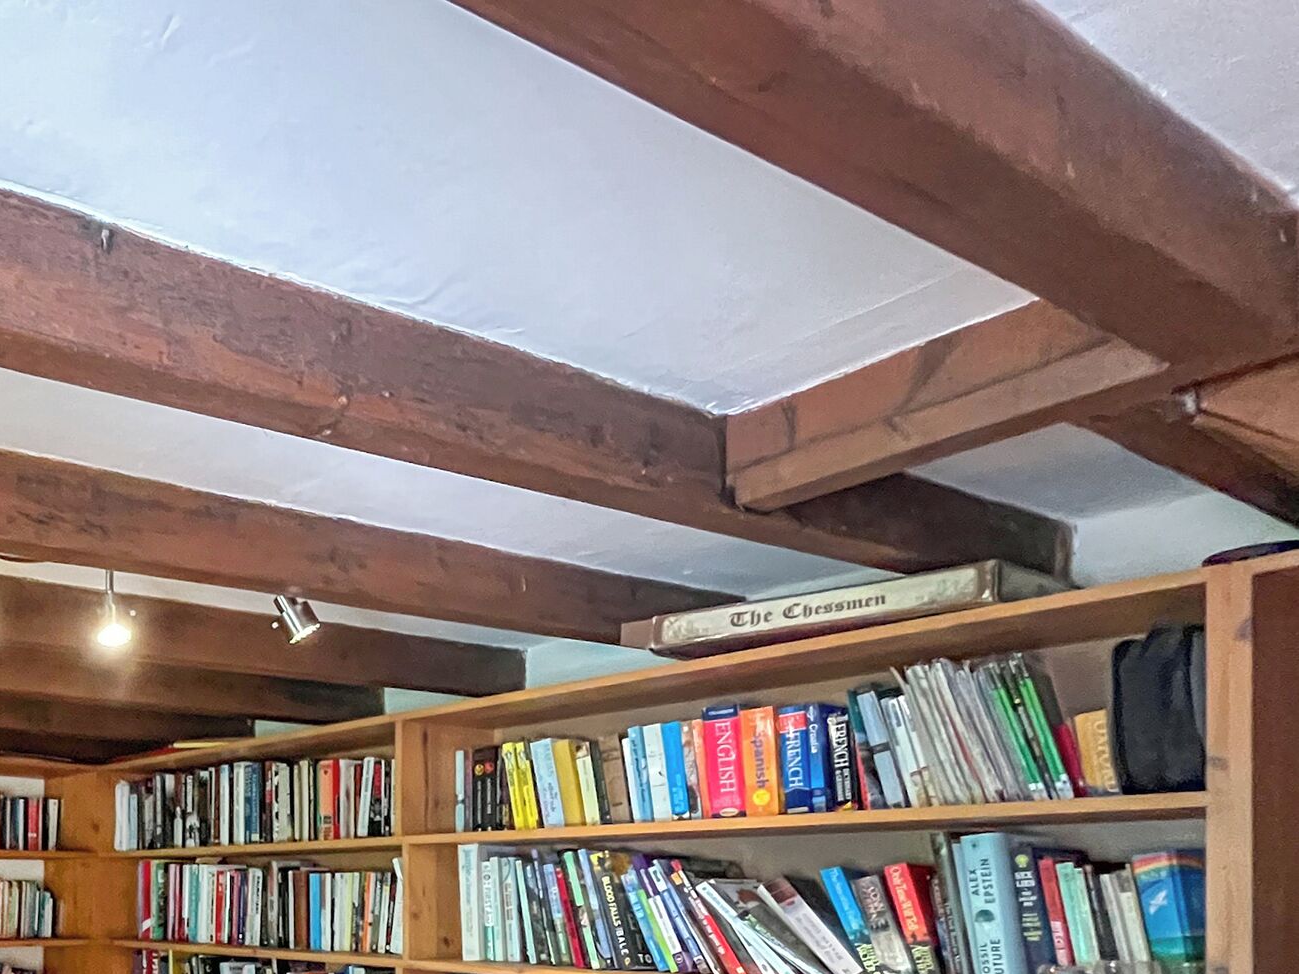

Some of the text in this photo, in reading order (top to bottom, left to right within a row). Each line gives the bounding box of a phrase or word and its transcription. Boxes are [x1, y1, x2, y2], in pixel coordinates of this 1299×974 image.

[728, 594, 888, 629] The Chessmen
[714, 720, 737, 793] ENGLISH
[786, 731, 805, 787] FRENCH
[834, 722, 850, 768] FRENCH
[601, 876, 614, 902] BLOOD
[608, 902, 622, 927] FALLS
[969, 868, 979, 896] ALEX
[980, 857, 996, 904] EPSTEIN
